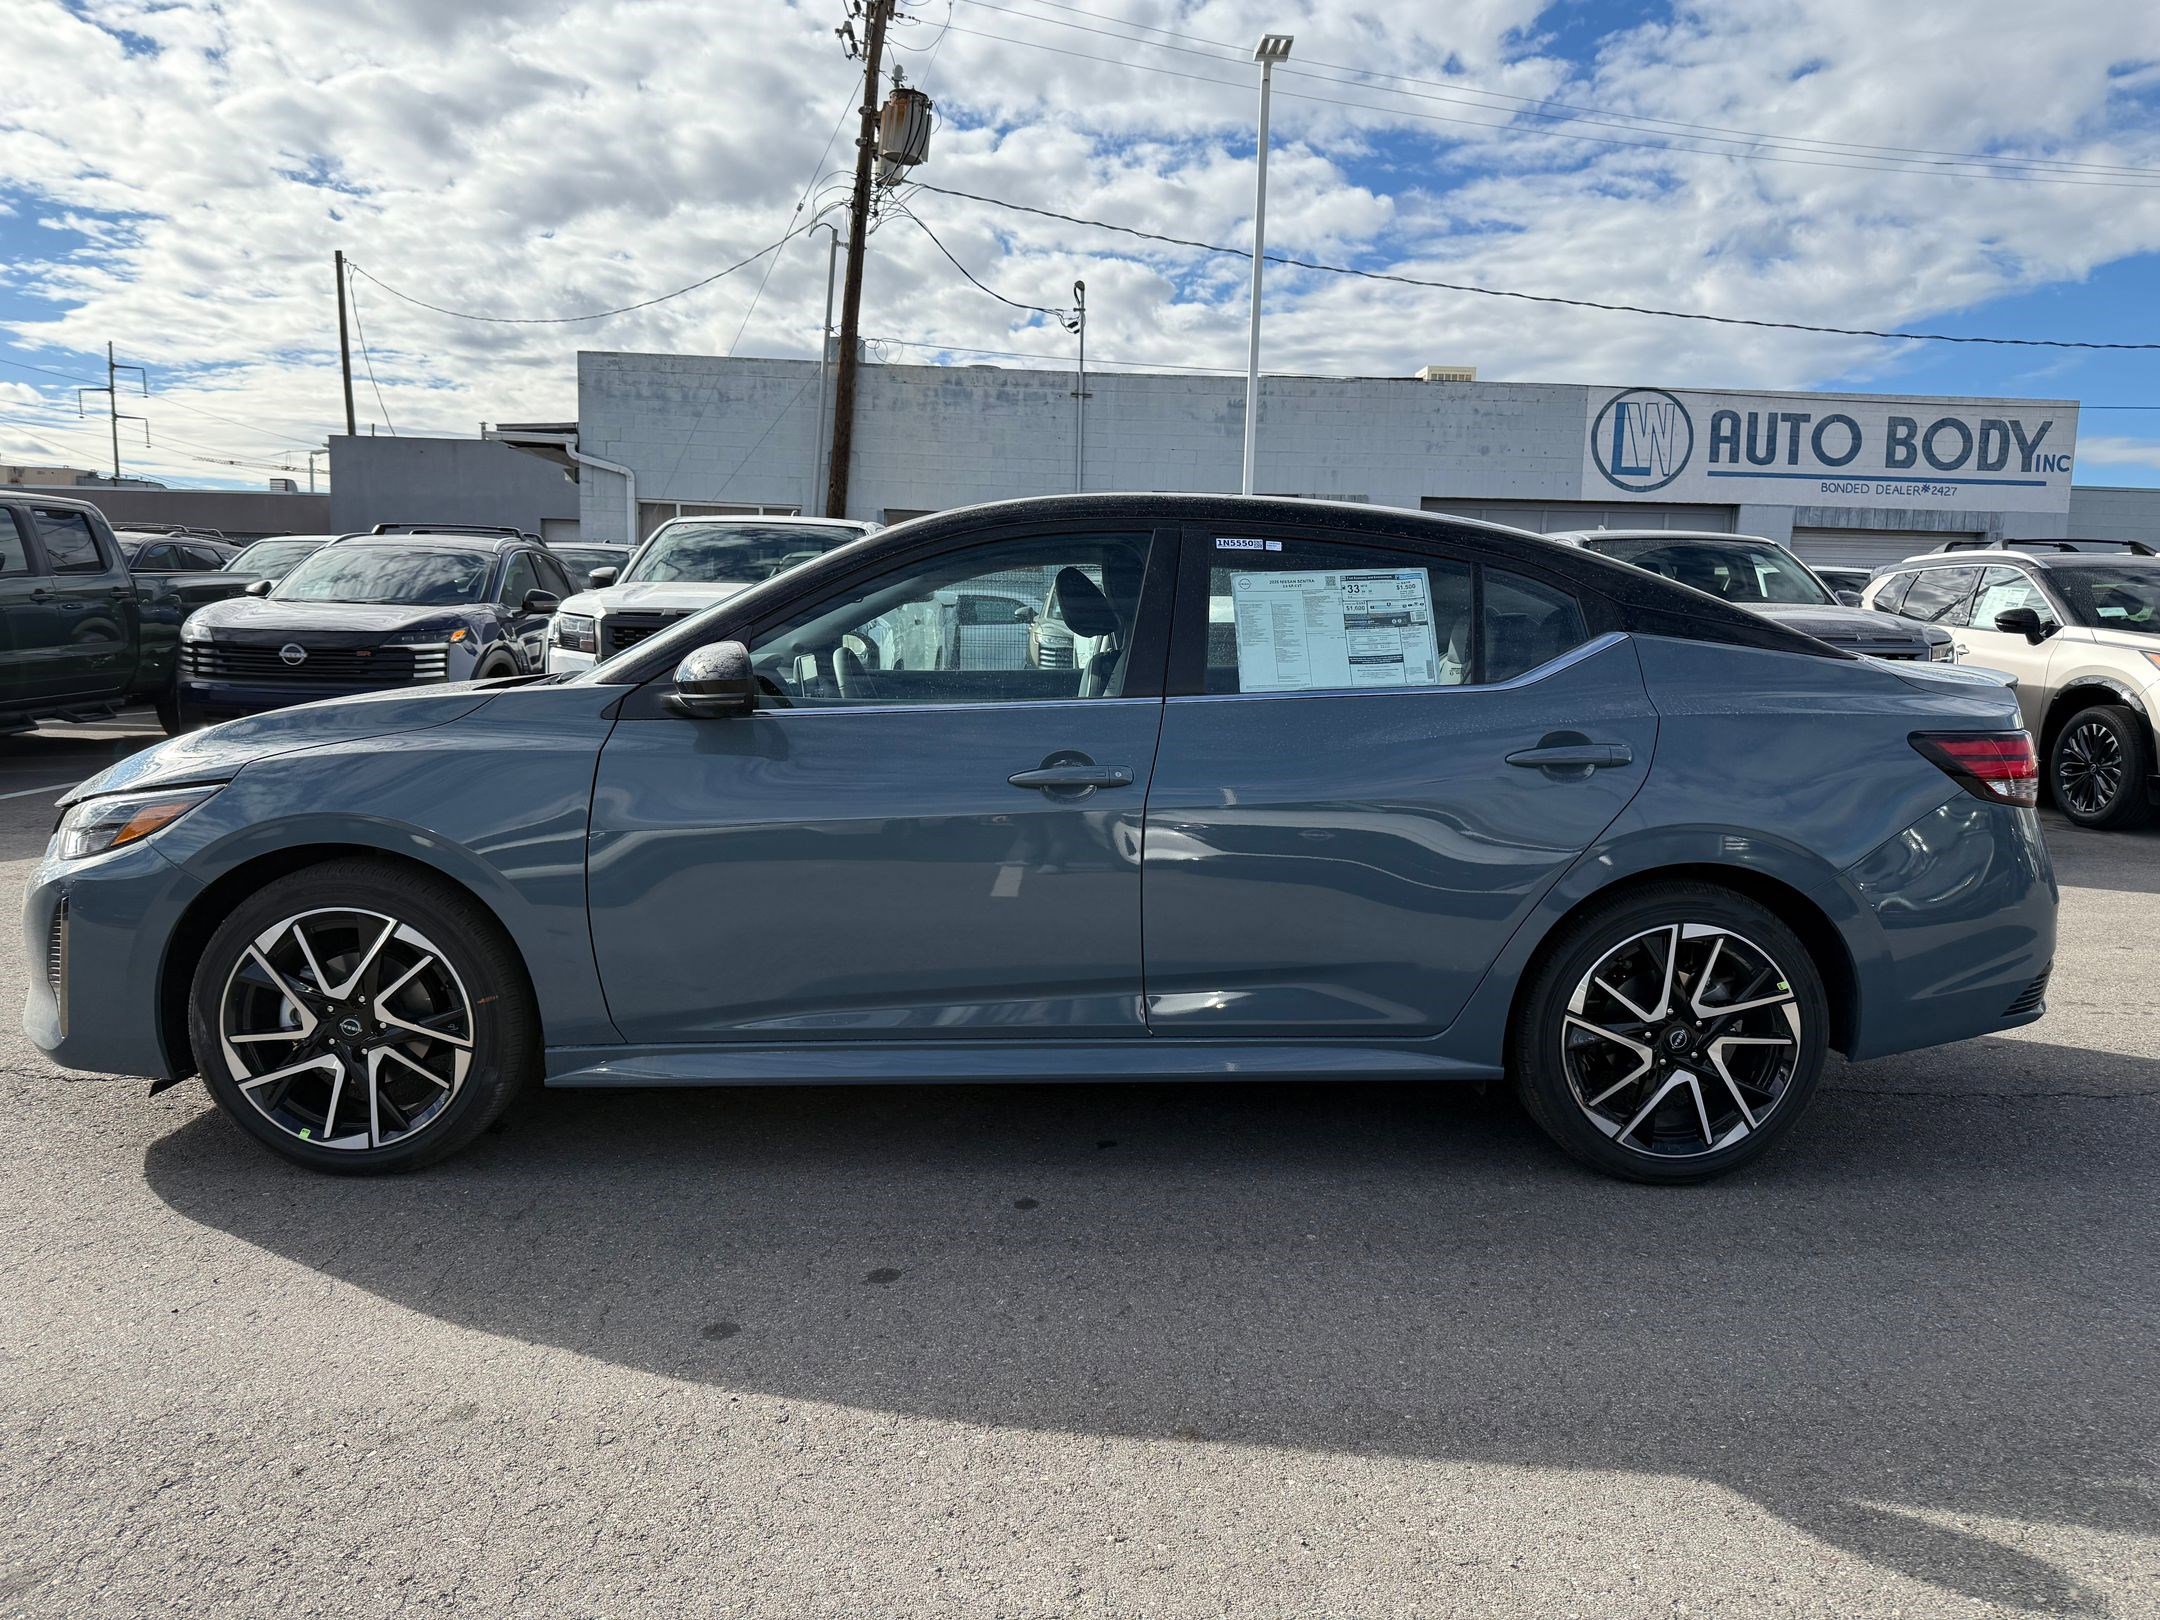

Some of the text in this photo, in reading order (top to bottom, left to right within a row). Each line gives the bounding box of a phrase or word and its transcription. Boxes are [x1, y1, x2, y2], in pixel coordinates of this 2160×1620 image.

[1611, 402, 1676, 477] LW
[1708, 409, 2071, 473] AUTO BODY INC
[1820, 482, 1870, 494] BONDED
[1347, 584, 1360, 594] 33
[1396, 583, 1416, 591] $1,500
